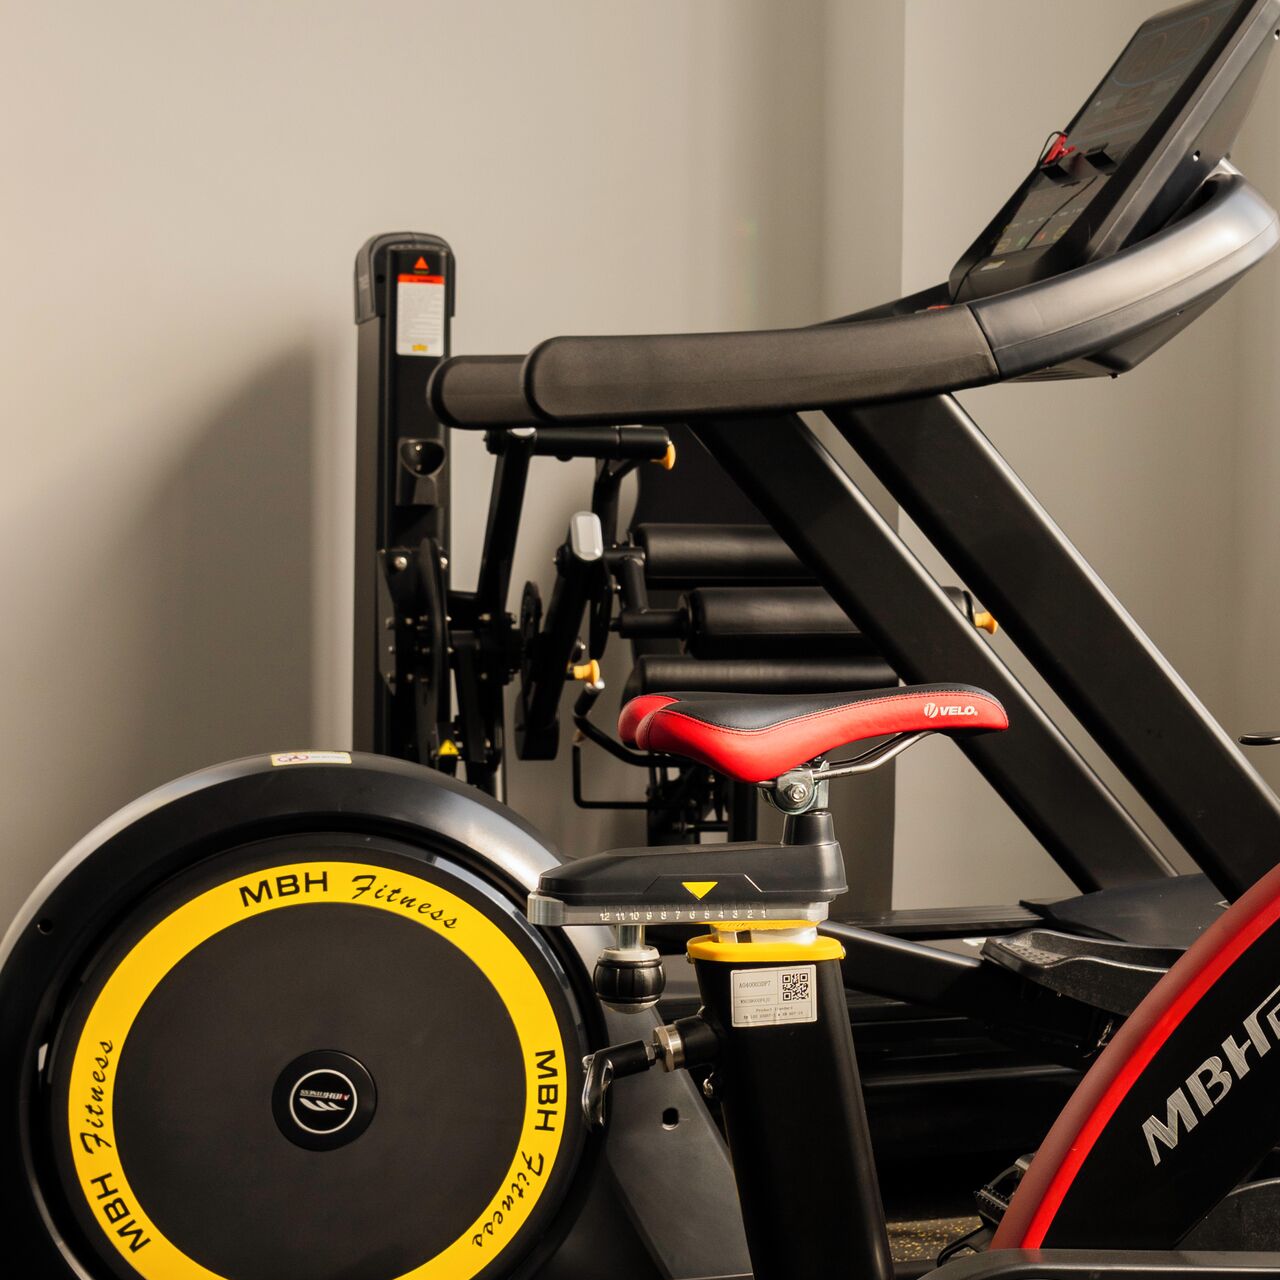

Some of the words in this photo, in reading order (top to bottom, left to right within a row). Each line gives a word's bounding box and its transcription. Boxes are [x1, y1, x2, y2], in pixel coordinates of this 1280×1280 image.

[940, 705, 975, 716] VELO
[239, 871, 328, 907] MBH
[352, 874, 457, 929] Fitness
[599, 912, 610, 921] 12
[616, 912, 626, 920] 11
[629, 911, 640, 920] 10
[675, 910, 681, 920] 7
[718, 909, 724, 919] 4
[747, 909, 753, 919] 2
[79, 1039, 114, 1155] Fitness
[534, 1049, 559, 1132] MBH
[1142, 1011, 1271, 1166] MBH
[90, 1172, 152, 1254] MBH
[471, 1150, 545, 1248] Fitness
